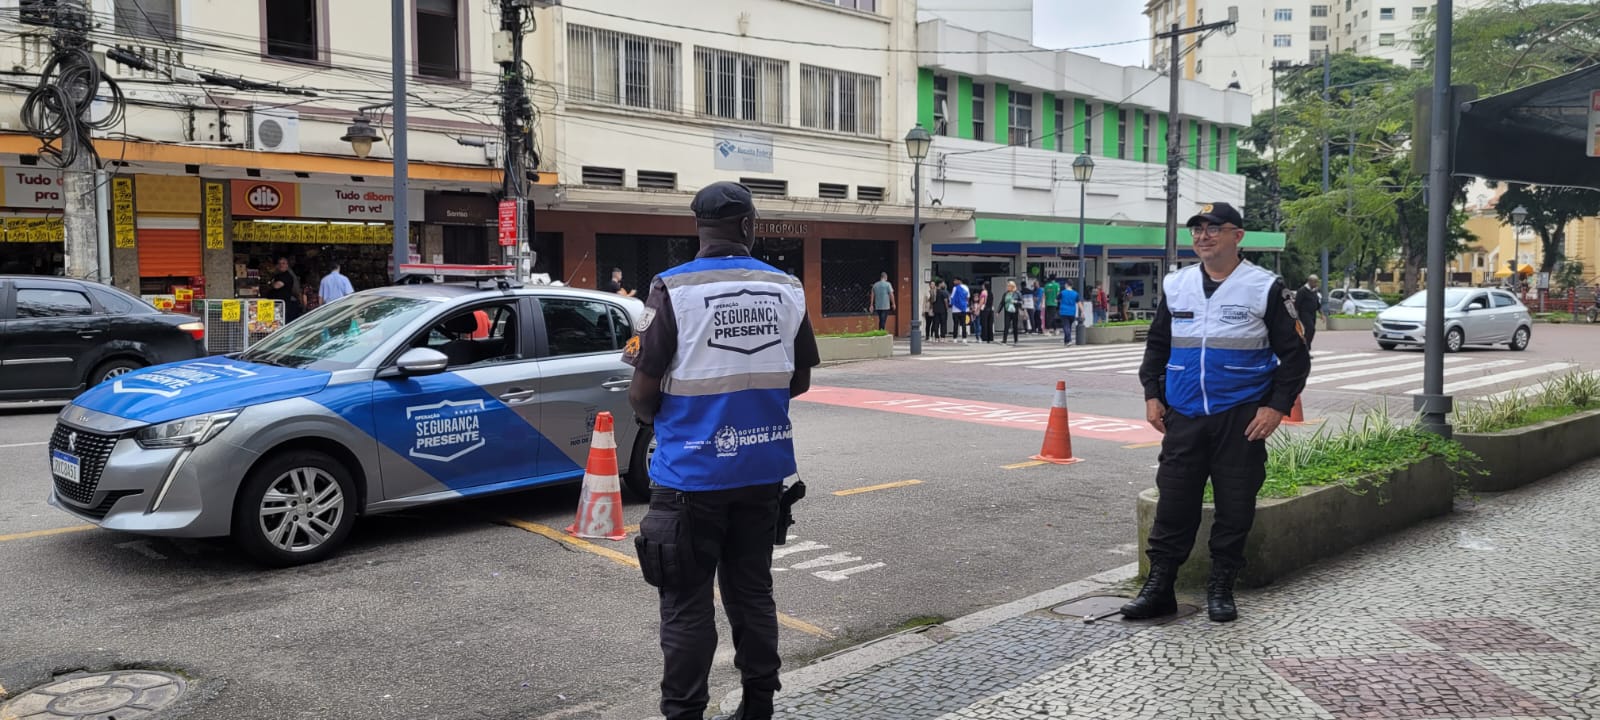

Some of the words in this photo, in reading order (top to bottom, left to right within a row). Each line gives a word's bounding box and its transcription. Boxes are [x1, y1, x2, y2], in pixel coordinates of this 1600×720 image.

[16, 173, 51, 185] Tudo
[35, 191, 59, 202] pra
[250, 186, 279, 206] dib
[335, 190, 360, 200] Tudo
[348, 204, 366, 214] pra
[714, 307, 779, 327] SEGURANÇA
[714, 324, 780, 339] PRESENTE
[863, 399, 1145, 432] ATENÇO
[415, 415, 480, 438] SEGURANÇA
[416, 430, 480, 449] PRESENTE
[740, 434, 757, 446] RIO
[757, 432, 770, 443] DE
